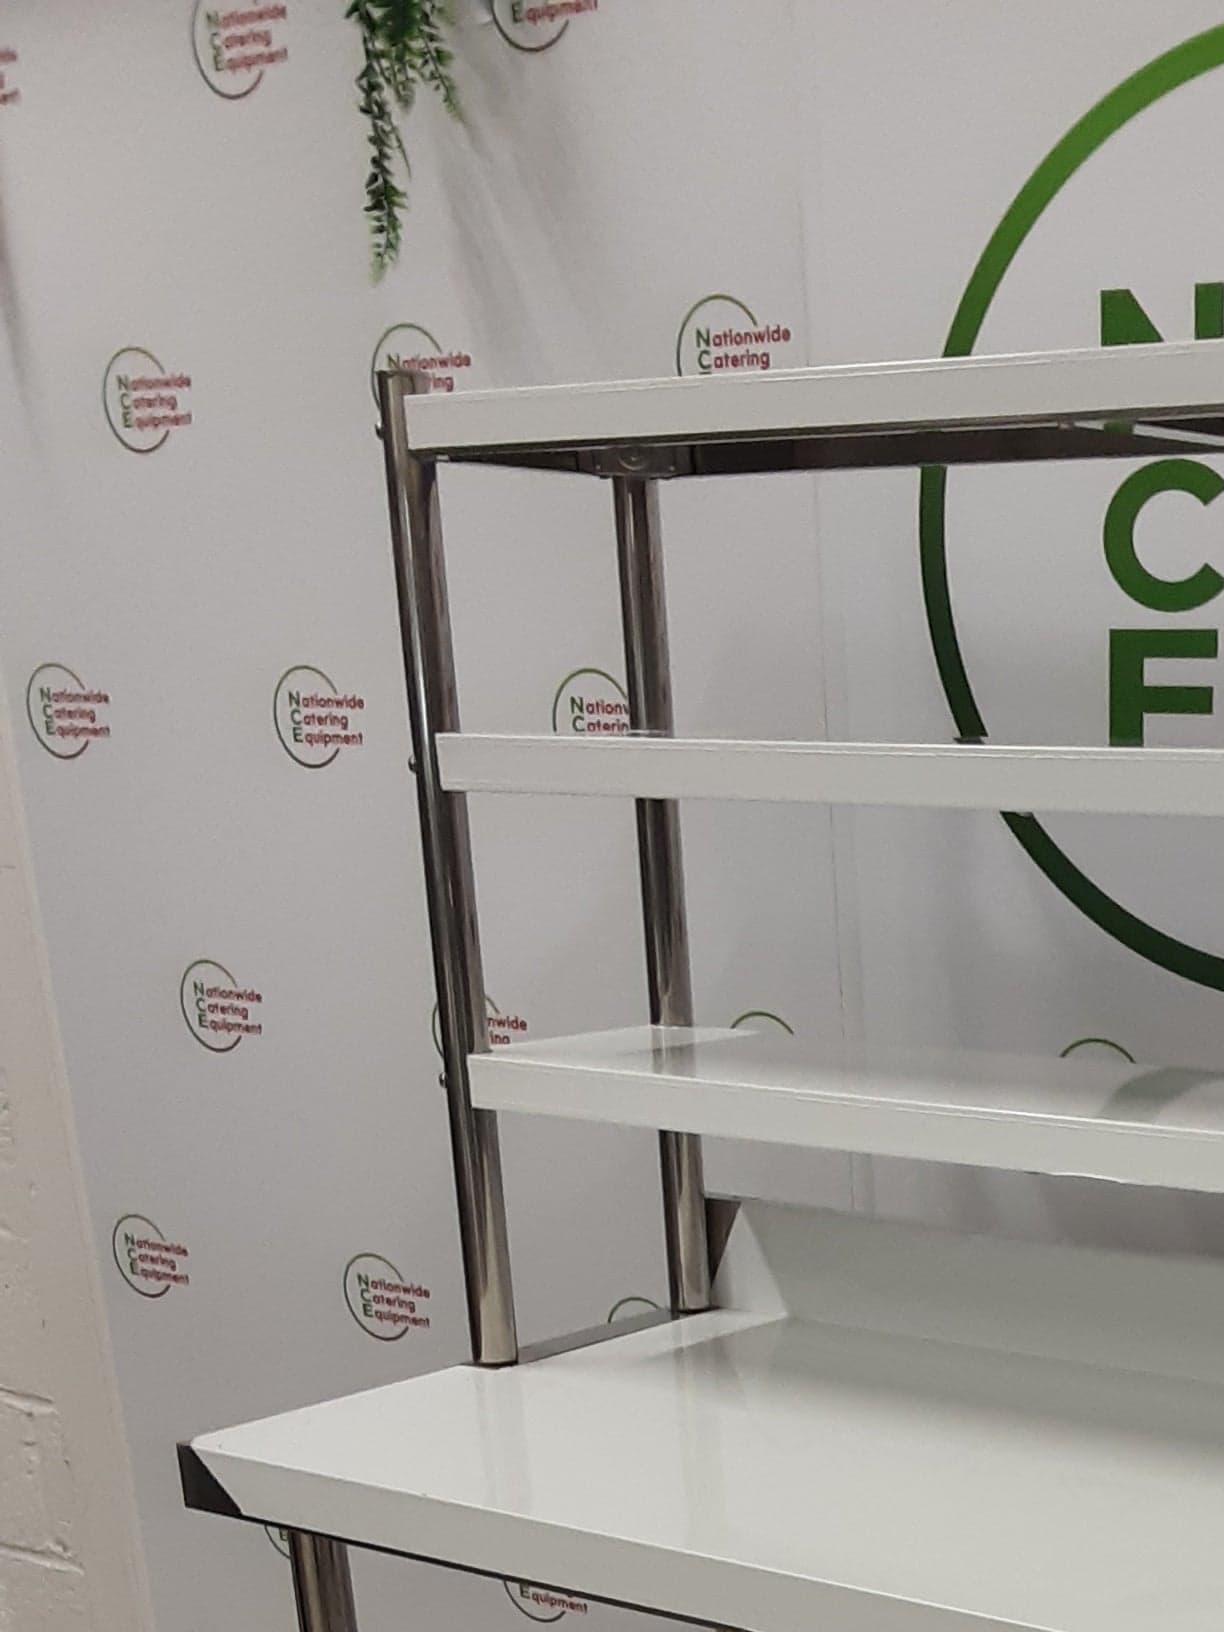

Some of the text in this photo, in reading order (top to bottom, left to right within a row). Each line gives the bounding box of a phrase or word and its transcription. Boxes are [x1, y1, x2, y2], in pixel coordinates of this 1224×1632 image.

[695, 325, 791, 348] Nationwide
[697, 349, 771, 371] Catering
[288, 691, 364, 711] Nationwide
[570, 696, 630, 714] Nation
[43, 703, 96, 725] Catering
[290, 708, 349, 731] Catering
[573, 715, 630, 732] Caterin
[293, 727, 363, 747] Equipment
[193, 981, 262, 1003] Nationwide
[196, 998, 248, 1020] Catering
[198, 1013, 262, 1035] Equipment
[357, 1274, 430, 1299] Nationwide
[360, 1290, 415, 1314] Catering
[362, 1302, 430, 1328] Equipment
[519, 1583, 588, 1615] Equipment
